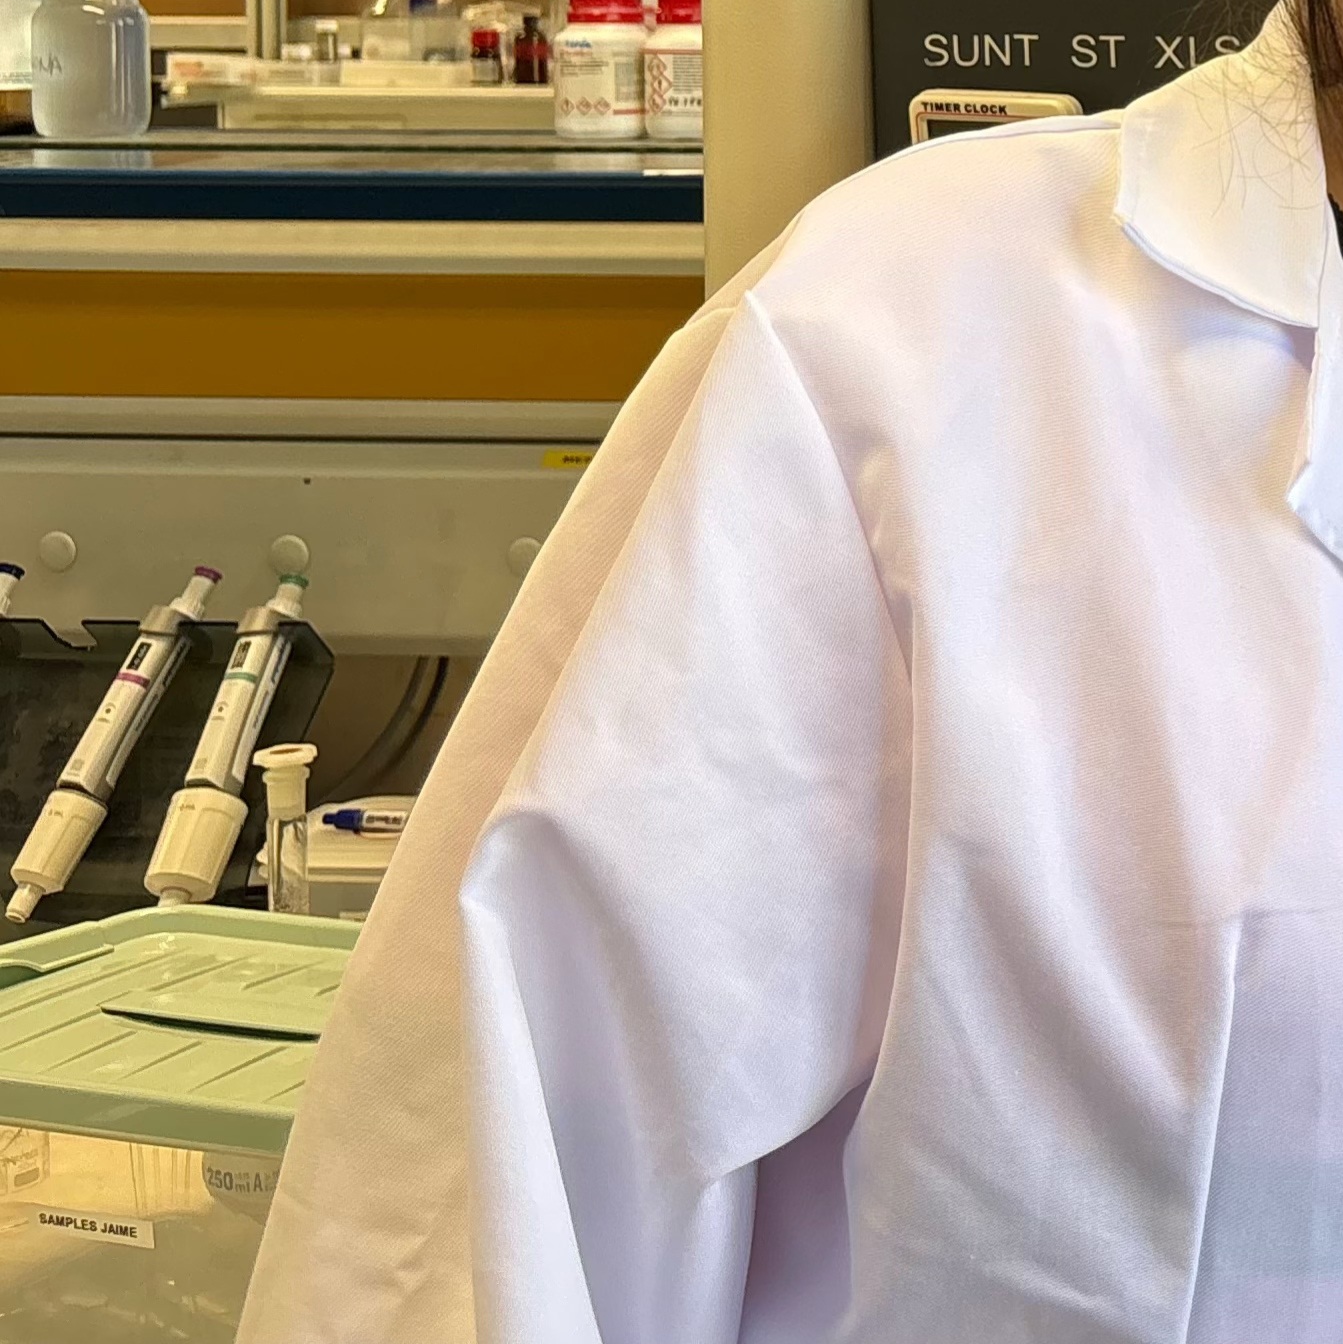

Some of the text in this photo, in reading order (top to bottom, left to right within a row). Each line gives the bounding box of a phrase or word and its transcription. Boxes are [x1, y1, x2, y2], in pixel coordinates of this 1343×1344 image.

[920, 101, 1009, 116] TIMER CLOCK
[206, 1165, 235, 1192] 250
[38, 1212, 138, 1239] SAMPLES JAIME
